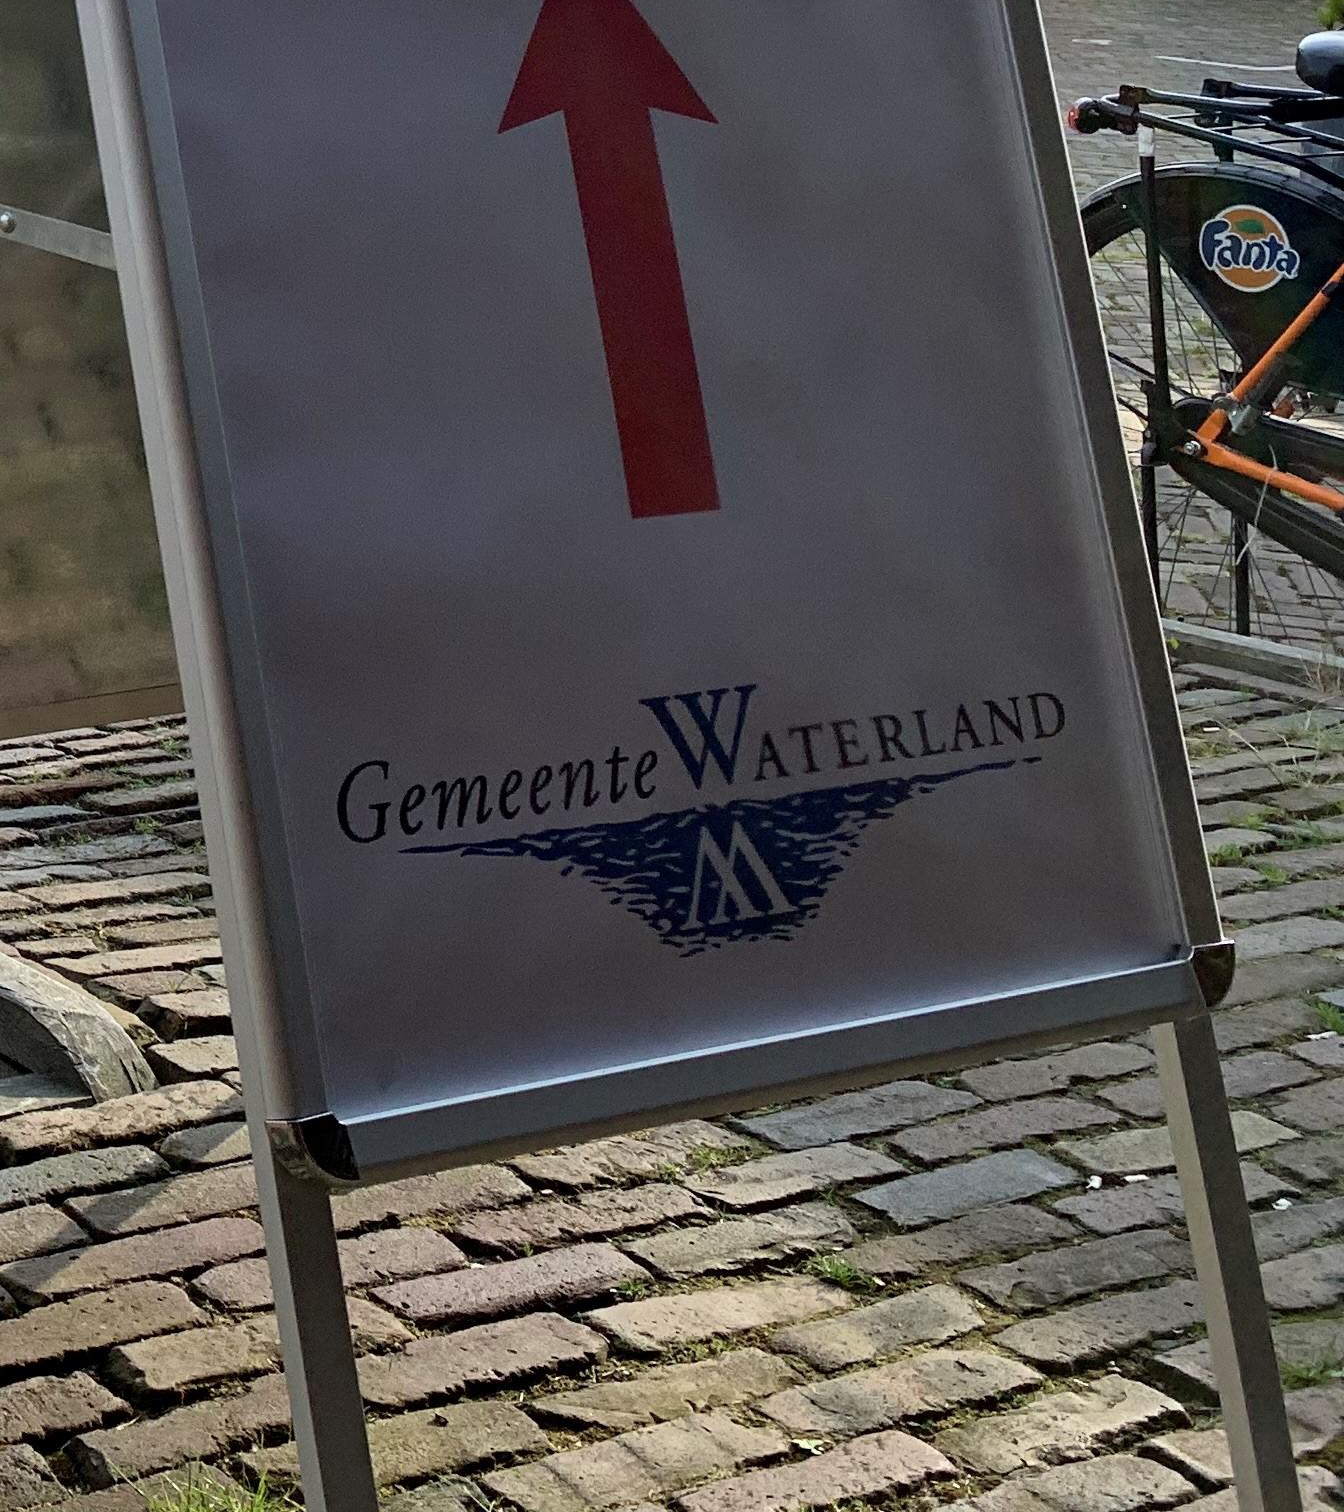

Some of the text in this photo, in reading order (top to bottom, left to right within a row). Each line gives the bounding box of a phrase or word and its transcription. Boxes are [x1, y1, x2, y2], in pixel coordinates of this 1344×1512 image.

[1200, 218, 1300, 278] Fanta
[336, 684, 1067, 844] Gemeente WATERLAND
